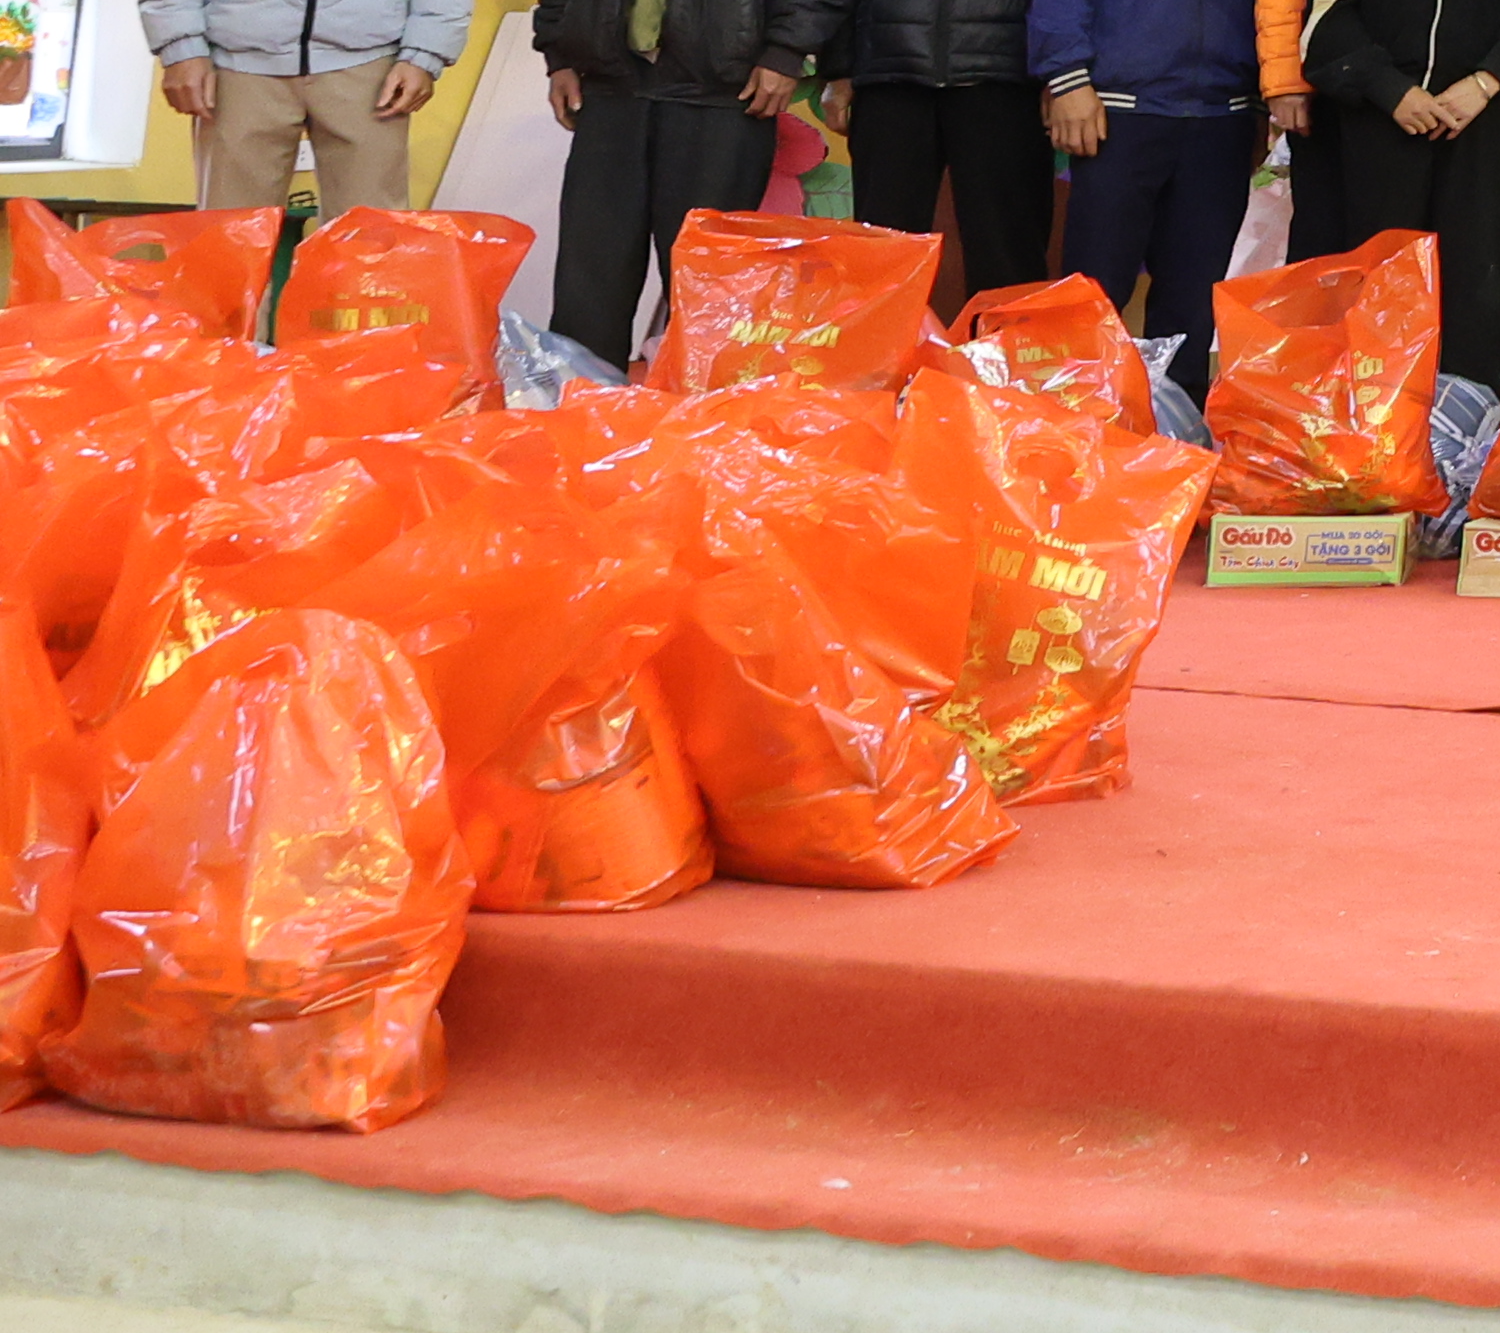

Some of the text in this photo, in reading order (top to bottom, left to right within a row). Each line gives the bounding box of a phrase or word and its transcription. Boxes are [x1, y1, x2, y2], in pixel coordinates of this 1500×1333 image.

[1222, 526, 1293, 545] Gấu Đỏ
[1311, 540, 1391, 558] TẶNG 3 GÓI
[1028, 555, 1108, 602] MỚI
